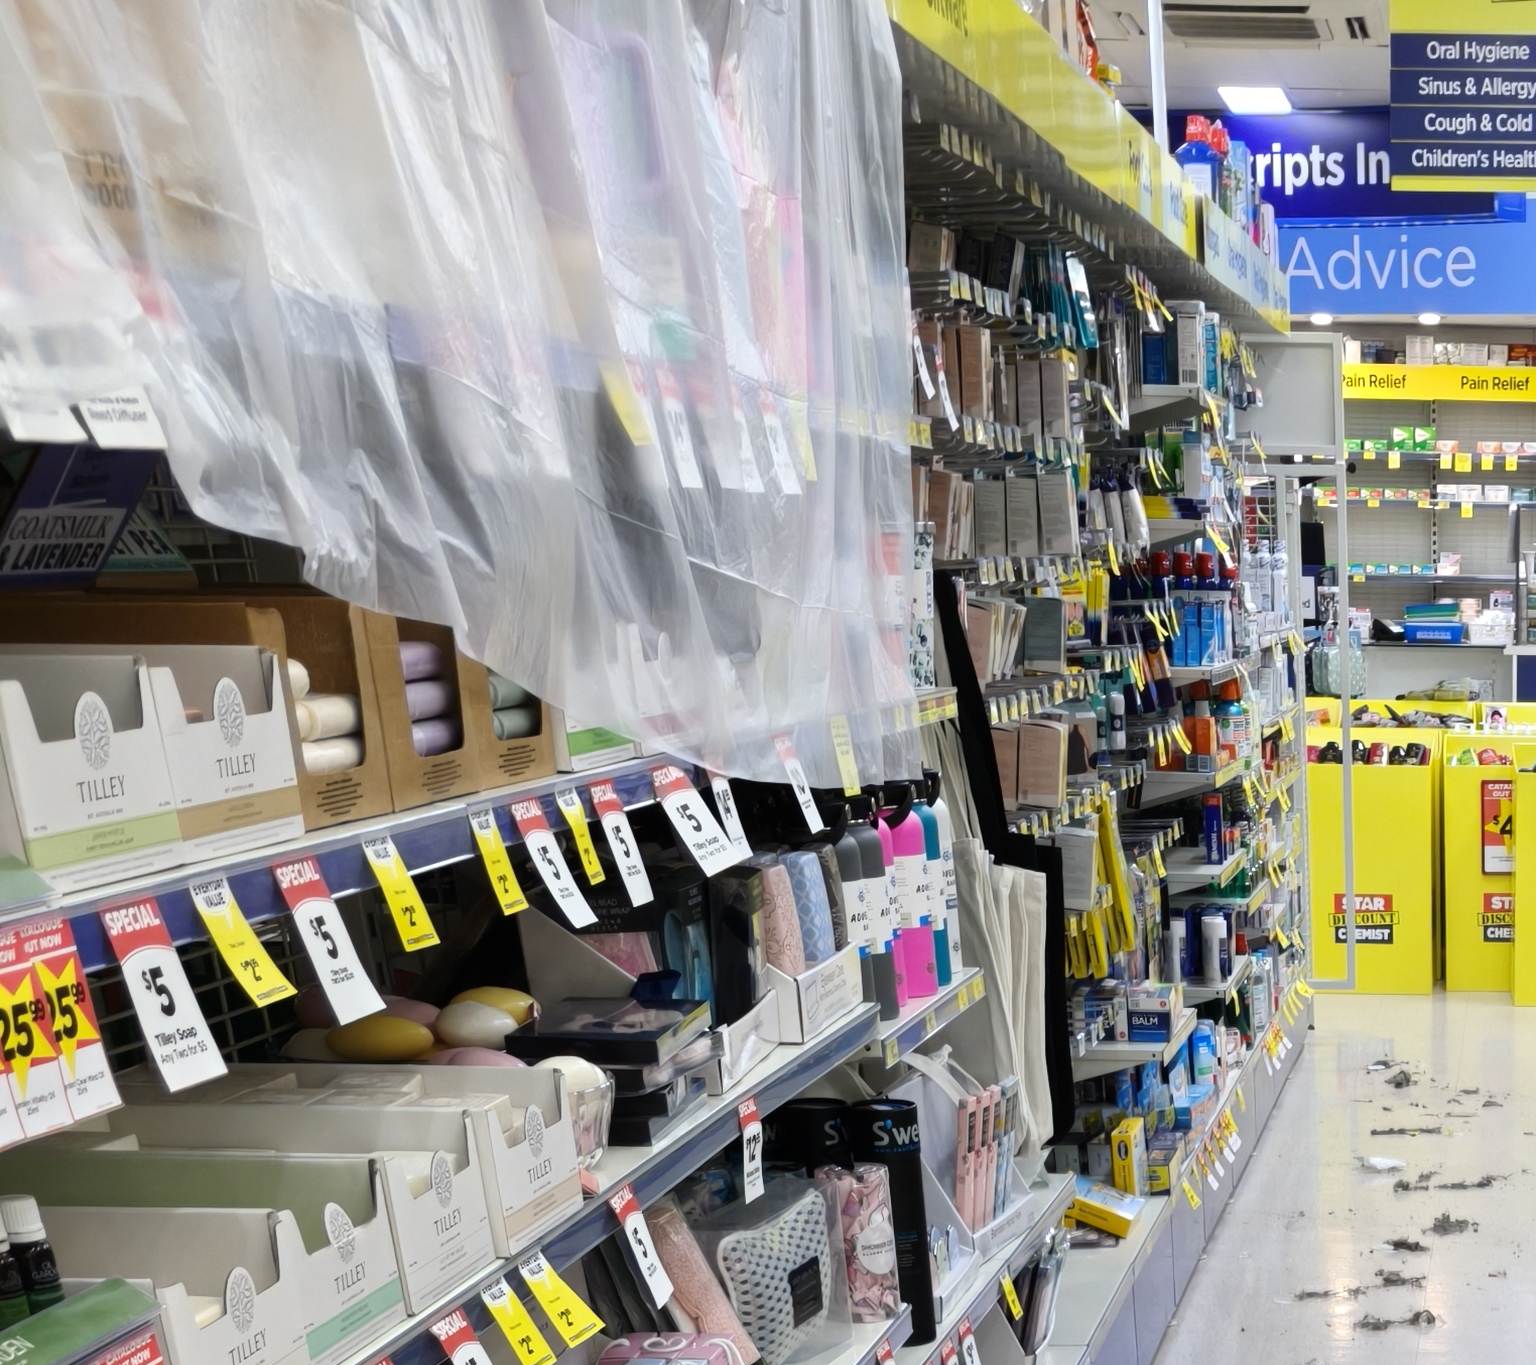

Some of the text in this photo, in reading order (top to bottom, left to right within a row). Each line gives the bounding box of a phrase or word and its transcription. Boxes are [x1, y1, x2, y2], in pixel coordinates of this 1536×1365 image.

[1427, 41, 1530, 63] Oral Hygiene
[1419, 77, 1460, 96] Sinus
[1465, 78, 1476, 96] &
[1425, 113, 1532, 134] Cough & Cold
[1250, 142, 1345, 195] ripts
[1412, 149, 1489, 168] Children's
[1286, 235, 1476, 290] Advice
[1369, 374, 1406, 389] Relief
[1461, 376, 1530, 391] Pain Relief
[9, 515, 113, 540] GOATSMILK
[128, 530, 174, 556] PEA
[12, 543, 105, 570] LAVENDER
[216, 753, 256, 779] TILLEY
[652, 766, 684, 786] SPECIAL
[77, 775, 124, 803] TILLEY
[591, 784, 617, 802] SPECIAL
[511, 800, 542, 819] SPECIAL
[677, 804, 702, 832] $5
[276, 861, 320, 888] SPECIAL
[105, 904, 160, 936] SPECIAL
[1333, 914, 1396, 926] DICOUNT
[309, 916, 338, 959] $5
[1338, 929, 1390, 940] CEMIST
[142, 966, 176, 1016] $5
[1132, 1017, 1158, 1025] BALM
[155, 1026, 198, 1047] Tilley Soap
[528, 1160, 552, 1184] TILLEY
[611, 1186, 634, 1212] SPECIAL
[434, 1208, 462, 1236] TILLEY
[335, 1261, 366, 1294] TILLEY
[432, 1311, 468, 1340] SPECIAL
